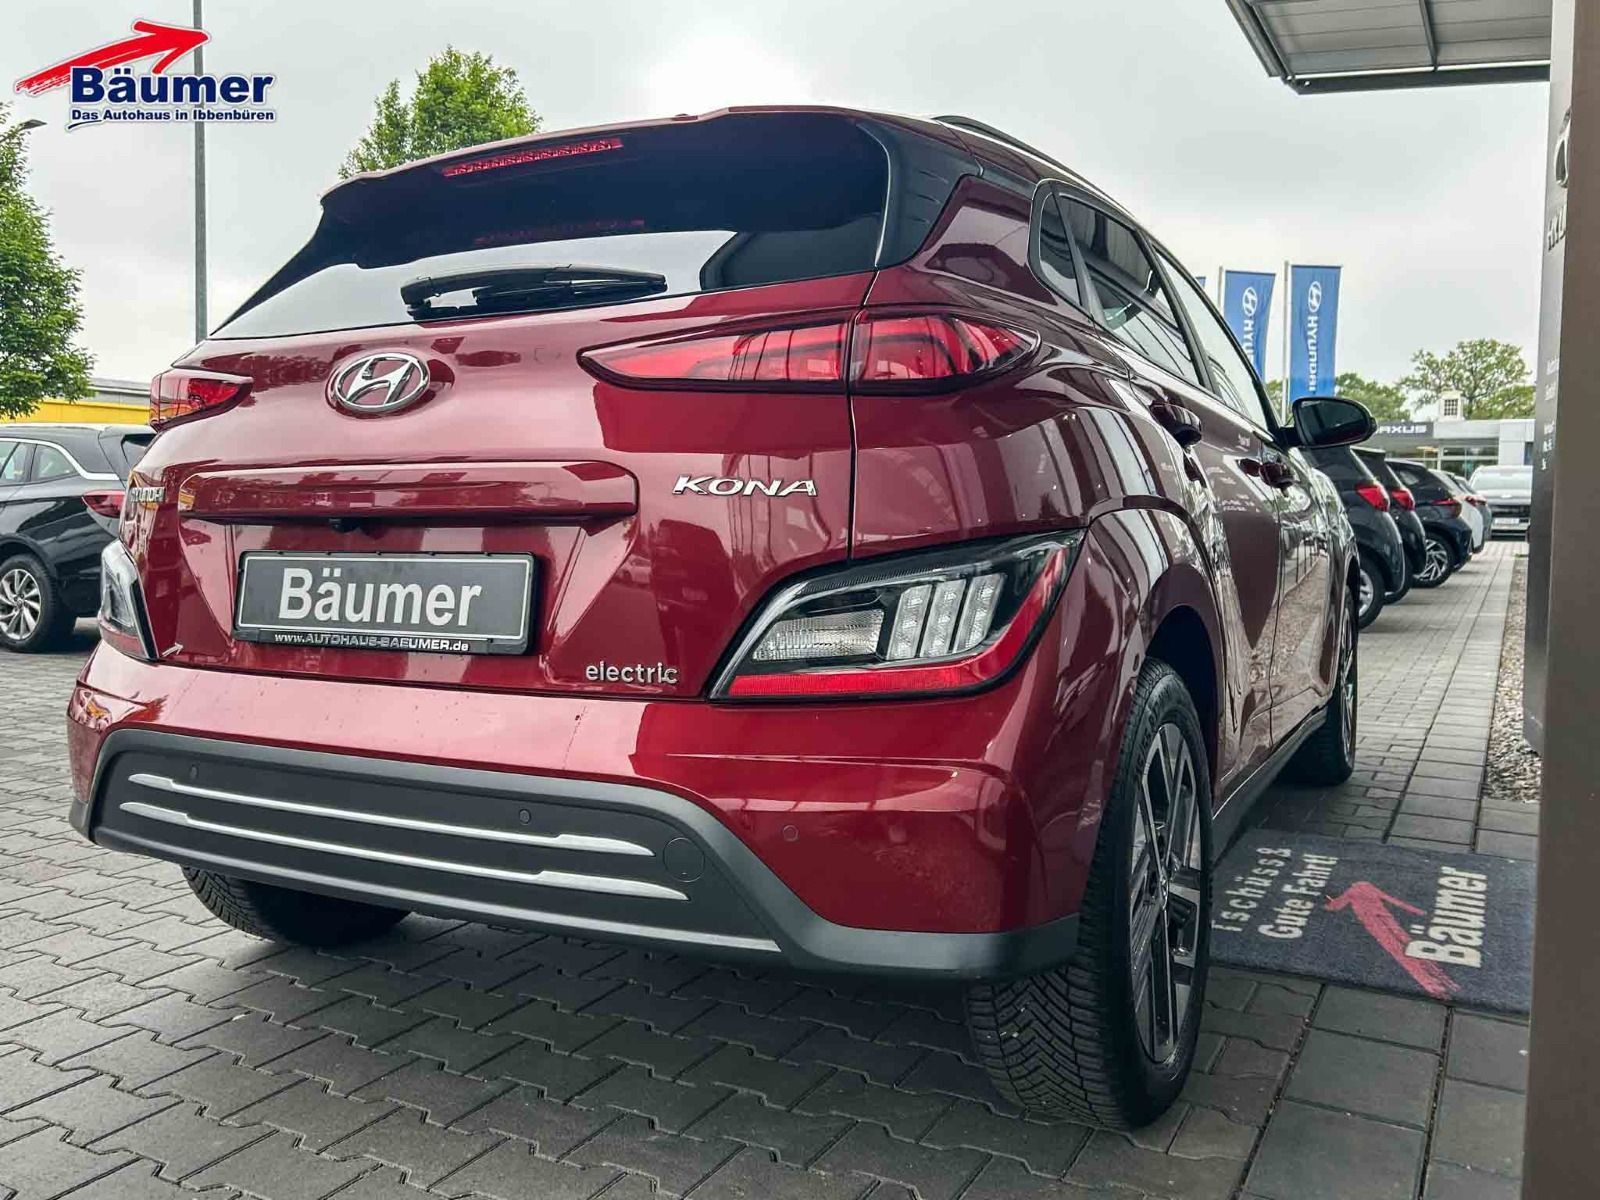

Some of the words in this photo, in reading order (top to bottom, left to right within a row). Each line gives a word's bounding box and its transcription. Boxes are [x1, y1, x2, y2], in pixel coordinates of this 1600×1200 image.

[1306, 315, 1319, 392] HYUNDAI
[1375, 425, 1427, 434] AXUS
[672, 474, 818, 497] KONA
[278, 567, 482, 626] Bäumer
[274, 633, 470, 652] www.AUTOHAUS-BAEUMER.de
[585, 661, 678, 684] electric
[1257, 898, 1315, 939] Gute
[1404, 865, 1488, 968] Bäumer
